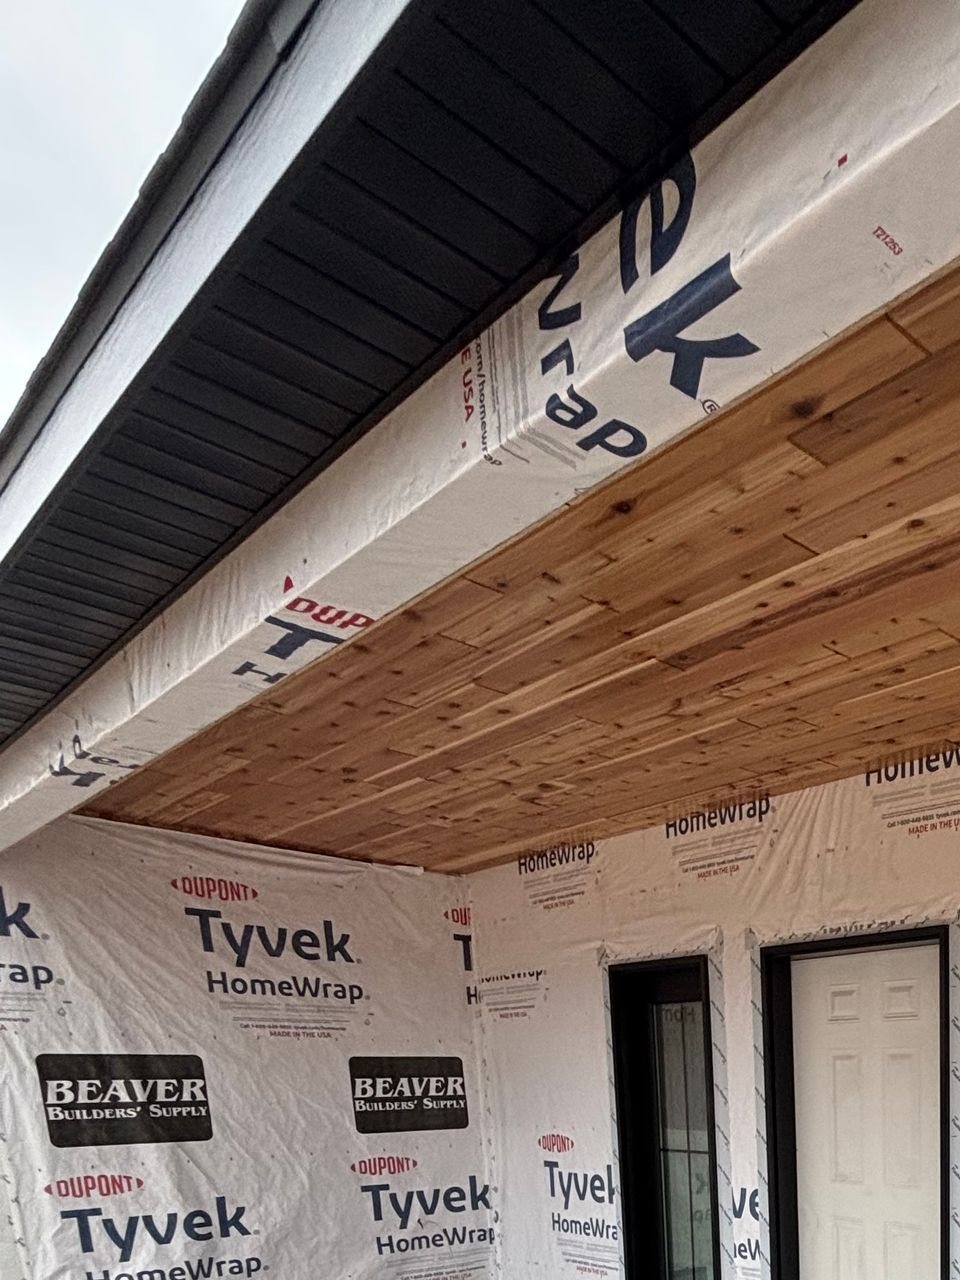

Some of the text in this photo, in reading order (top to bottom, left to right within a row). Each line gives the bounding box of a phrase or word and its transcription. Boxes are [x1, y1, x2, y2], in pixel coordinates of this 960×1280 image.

[462, 368, 474, 422] USA
[908, 826, 928, 835] MADE
[939, 821, 952, 830] THE
[182, 877, 249, 901] DUPONT
[184, 907, 355, 968] Tyvek
[0, 963, 53, 990] ap
[206, 971, 364, 1004] HomeWrap
[45, 1078, 207, 1104] BEAVER
[354, 1077, 465, 1098] BEAVER
[541, 1133, 571, 1152] DUPONT
[359, 1156, 410, 1175] DUPONT
[56, 1174, 132, 1198] DUPONT
[361, 1175, 491, 1229] Tyvek
[60, 1196, 252, 1263] Tyvek
[376, 1226, 495, 1255] HomeWrap
